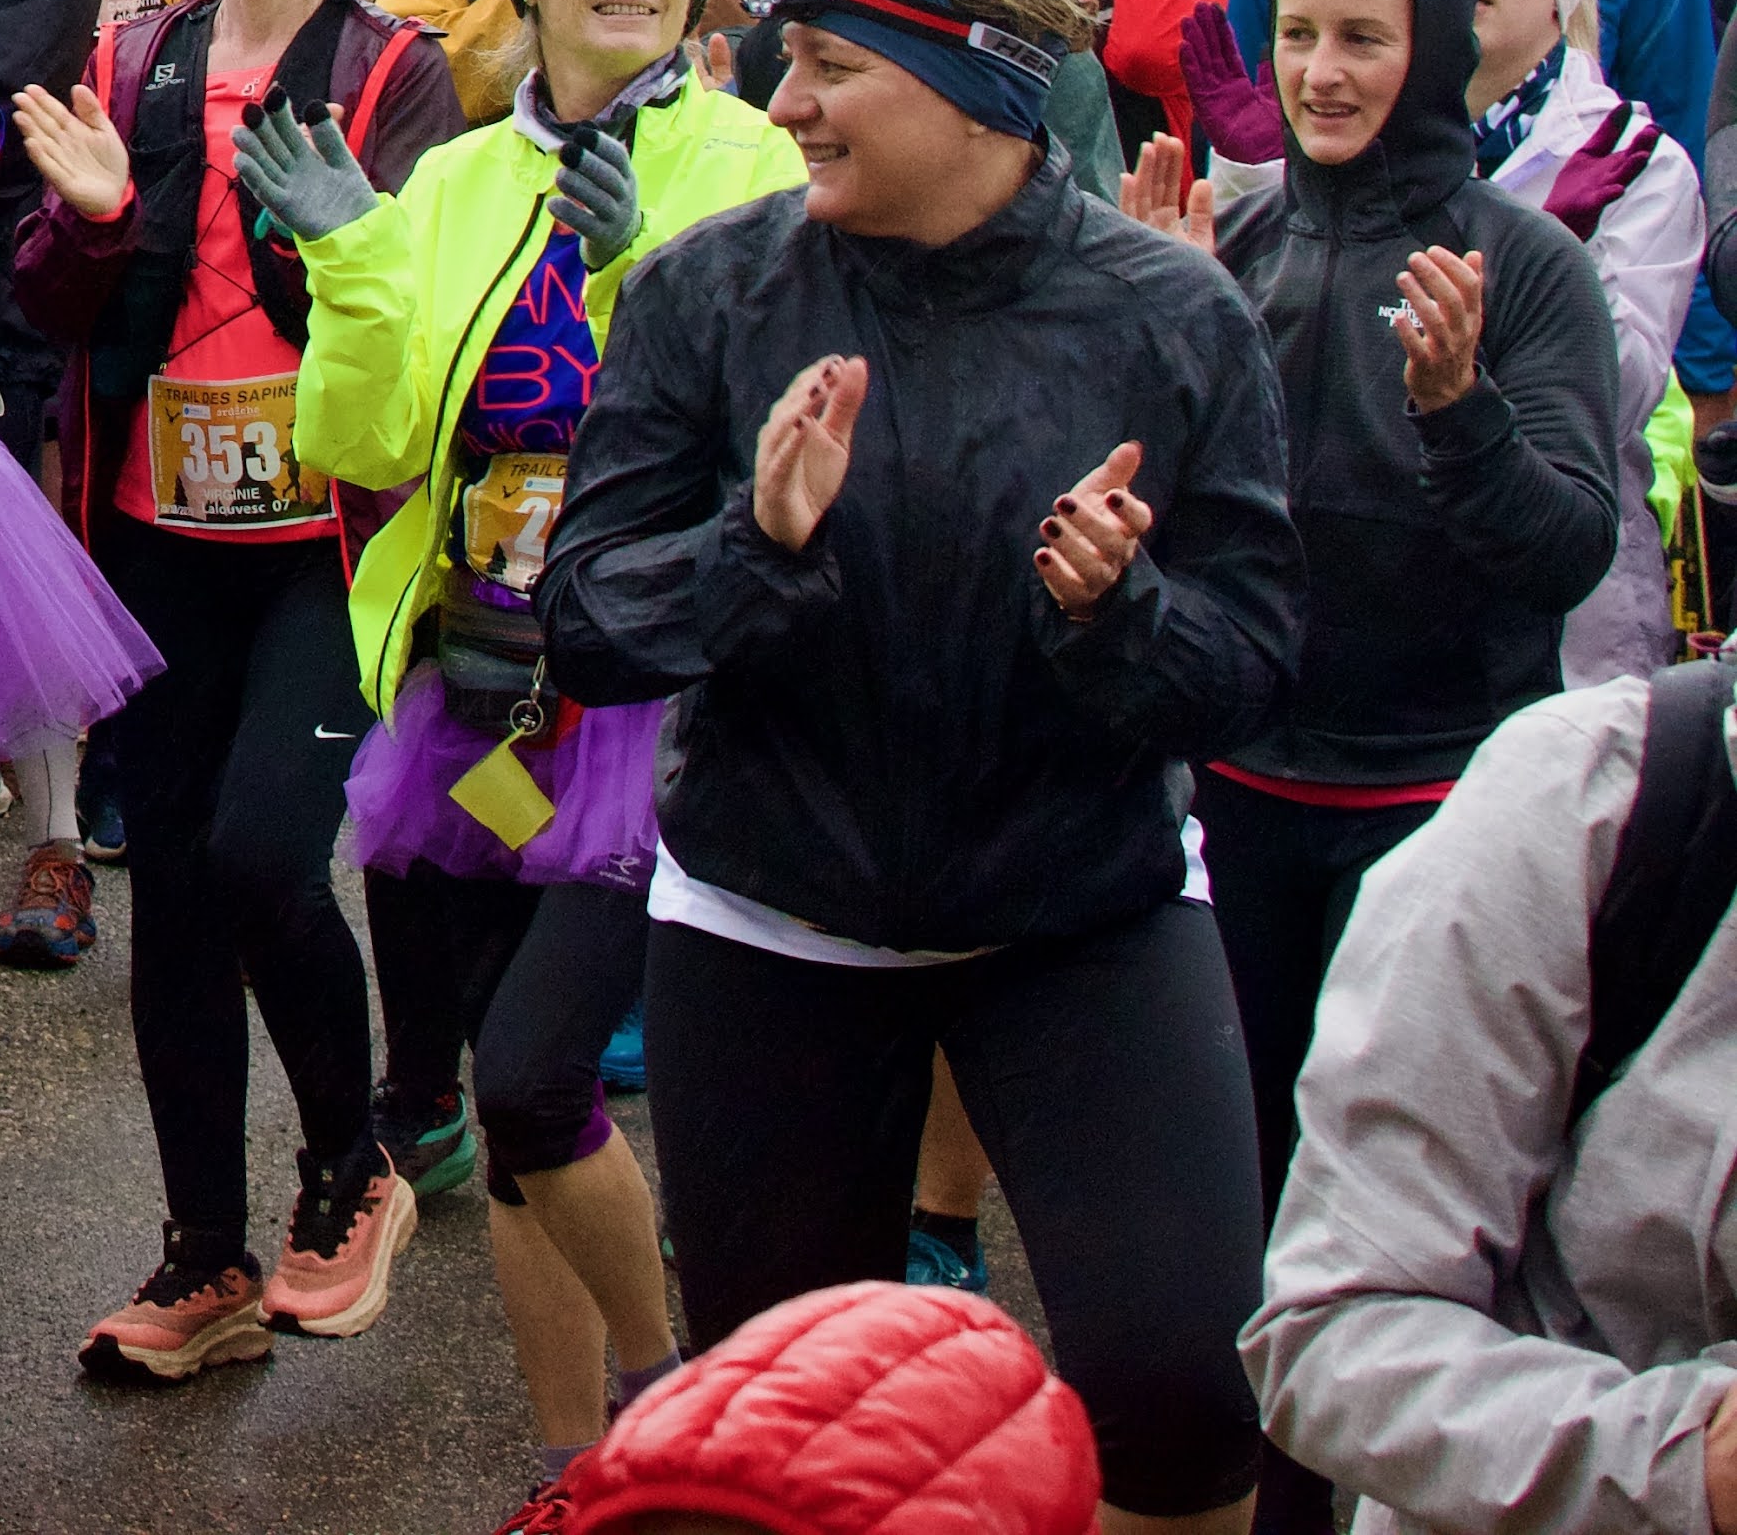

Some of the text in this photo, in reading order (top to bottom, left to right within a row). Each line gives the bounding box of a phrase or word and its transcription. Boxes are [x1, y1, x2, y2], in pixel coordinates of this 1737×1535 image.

[476, 344, 602, 411] BY
[165, 383, 297, 405] TRAIL DES SAPINS
[180, 421, 282, 484] 353
[510, 463, 553, 477] TRAIL
[202, 502, 266, 516] Lalouvesc
[271, 499, 290, 513] 07
